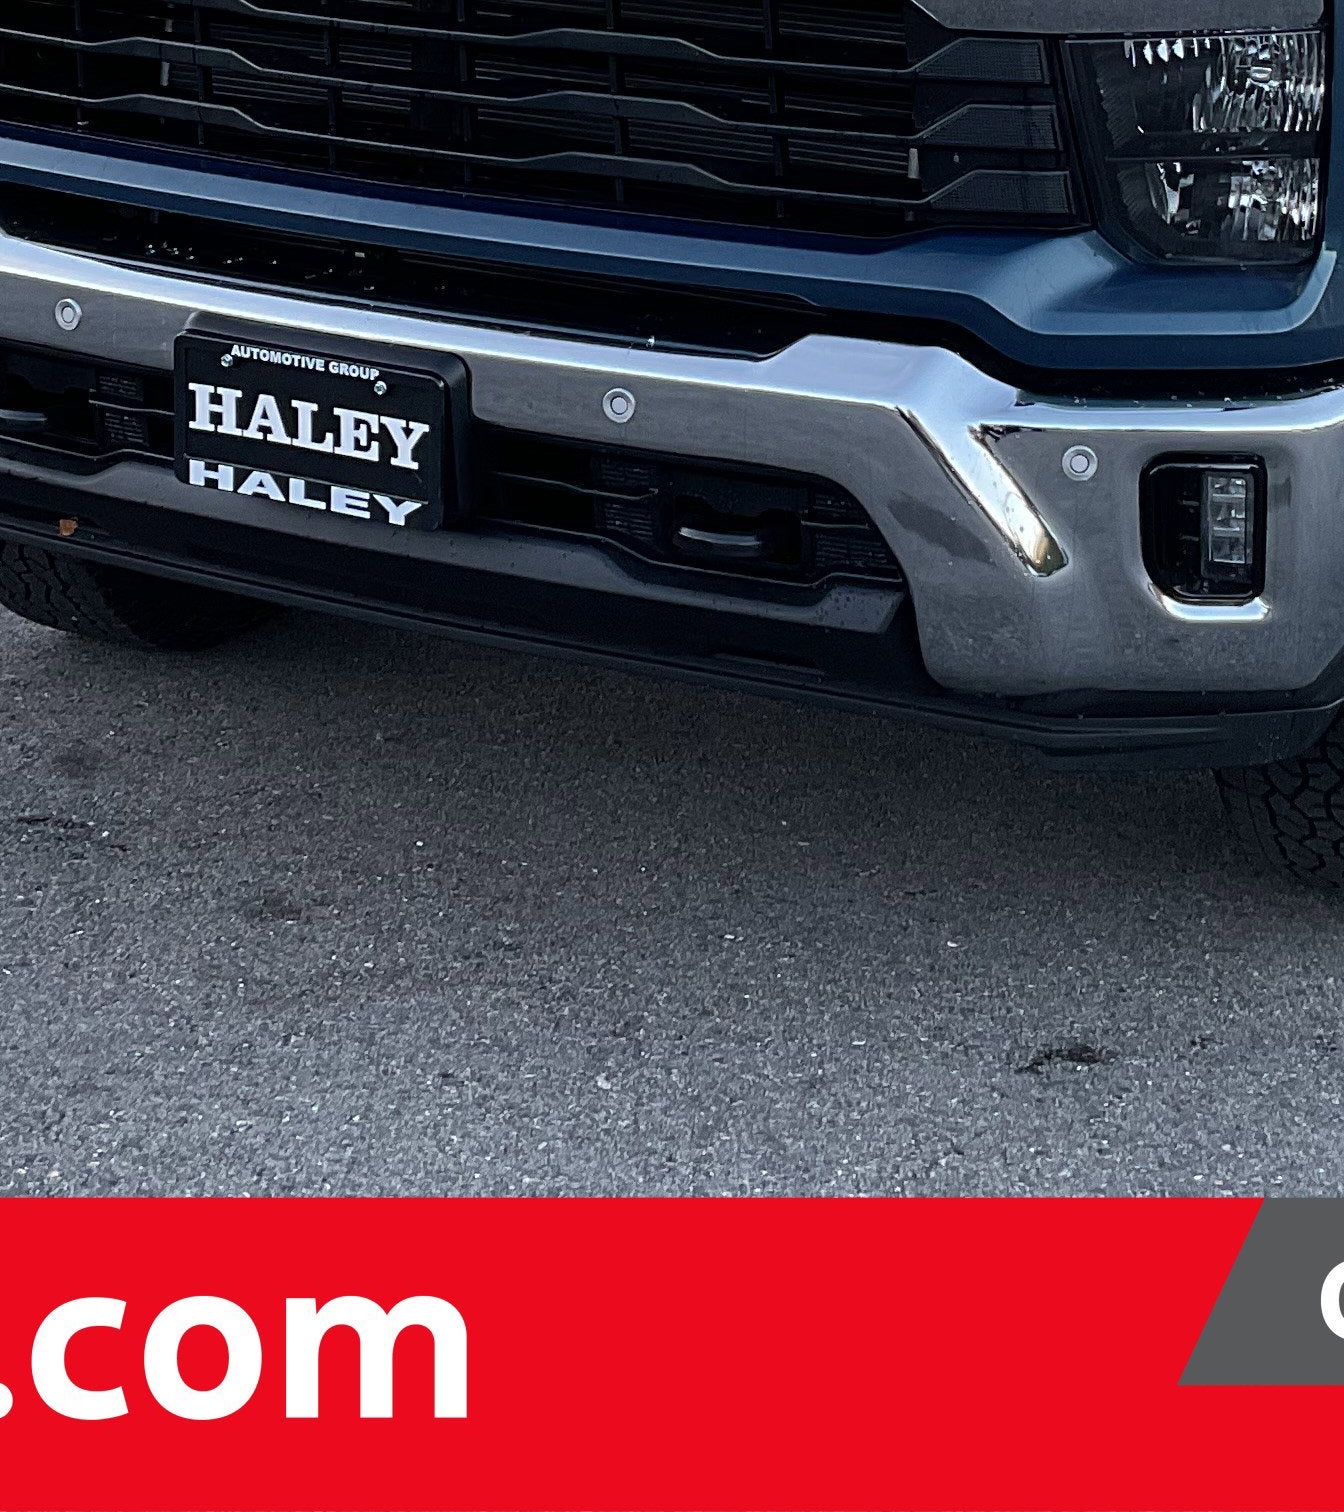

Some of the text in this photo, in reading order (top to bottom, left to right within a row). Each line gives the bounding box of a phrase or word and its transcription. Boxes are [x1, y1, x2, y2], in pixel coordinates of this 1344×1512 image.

[230, 344, 381, 381] AUTOMOTIVE GROUP
[188, 382, 431, 470] HALEY
[188, 458, 423, 527] HALEY
